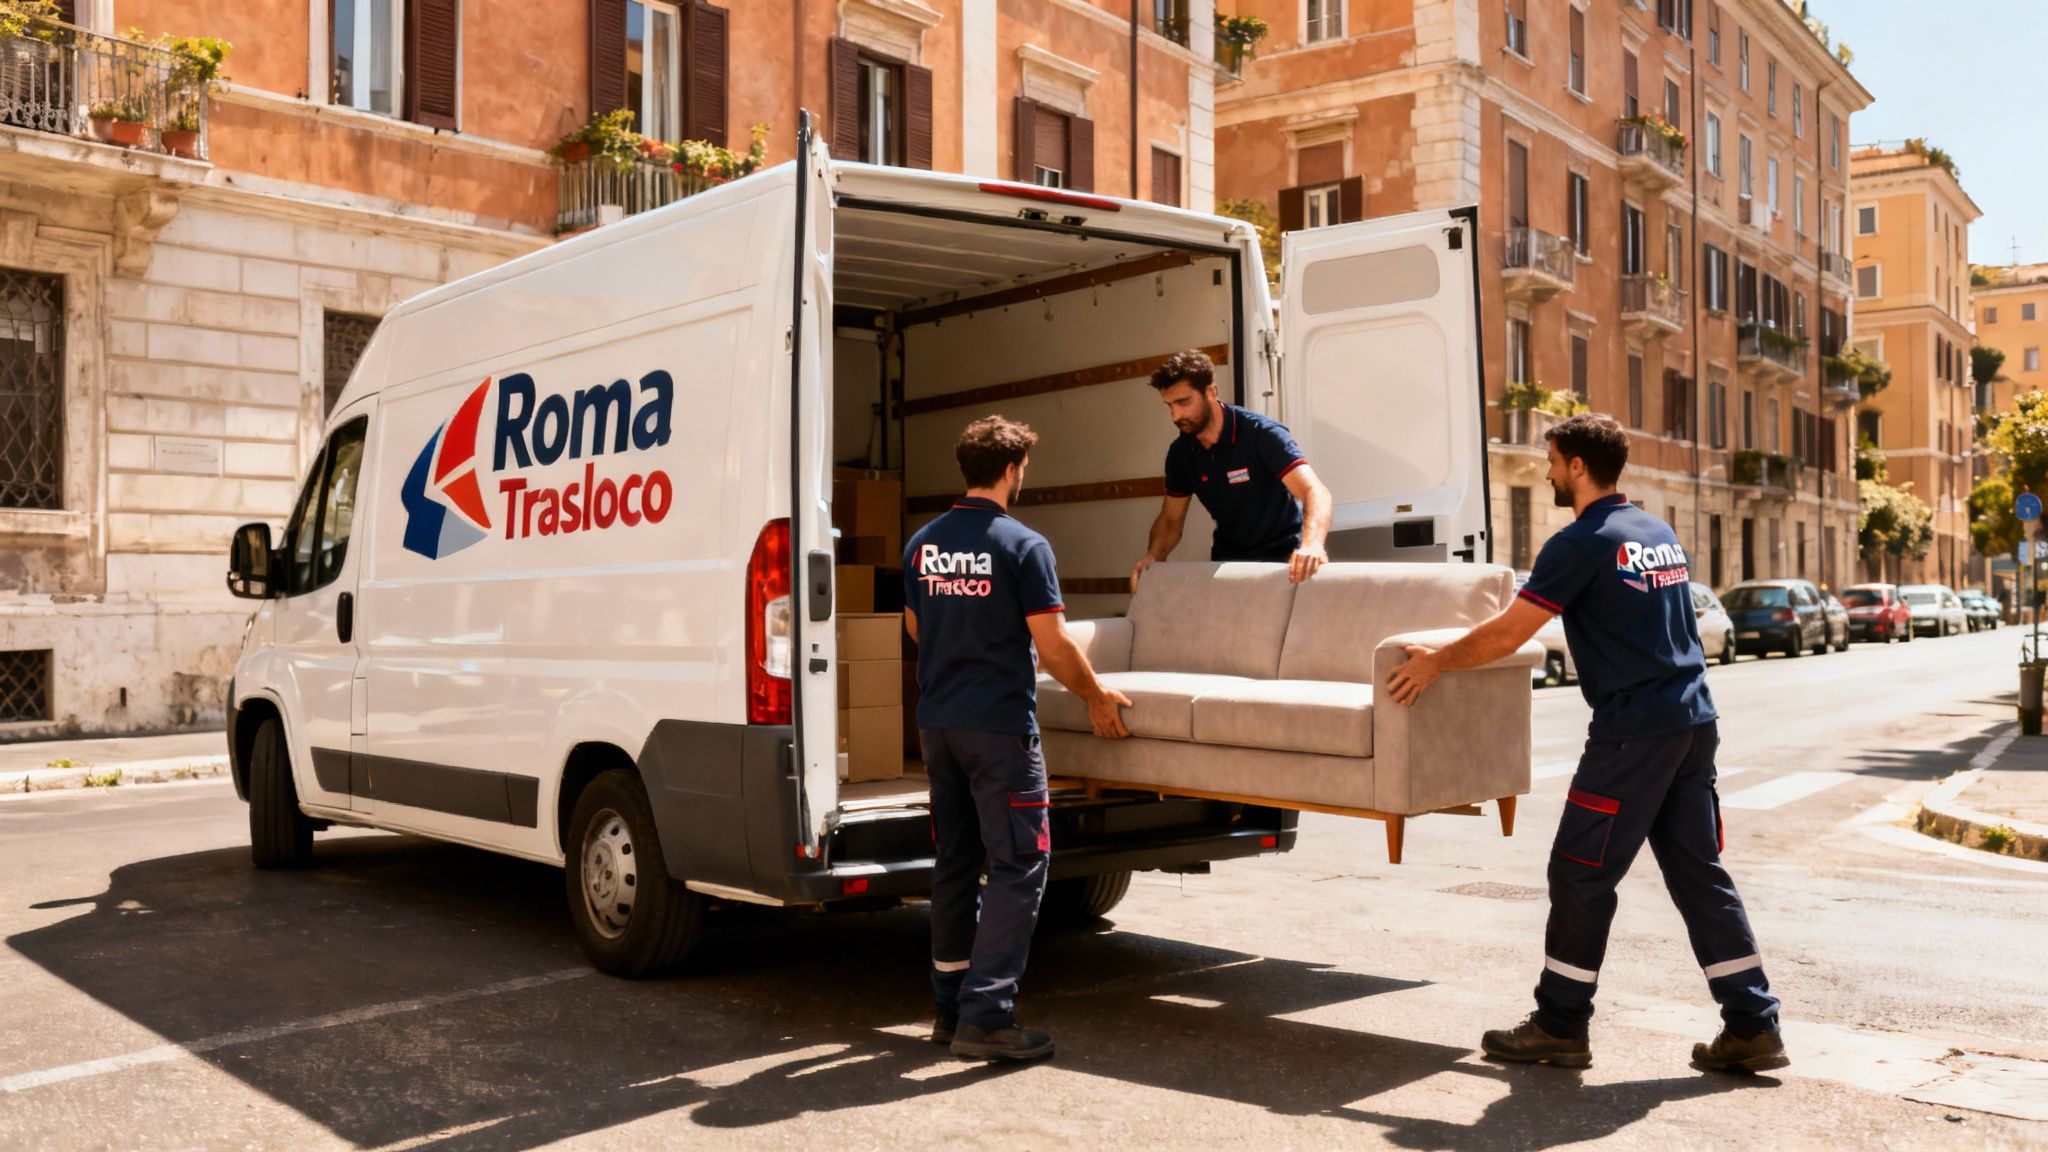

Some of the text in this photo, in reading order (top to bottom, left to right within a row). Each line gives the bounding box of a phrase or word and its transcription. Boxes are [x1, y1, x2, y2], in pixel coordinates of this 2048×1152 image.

[493, 369, 674, 472] Roma
[499, 462, 673, 540] Trasloco
[919, 544, 993, 575] Roma
